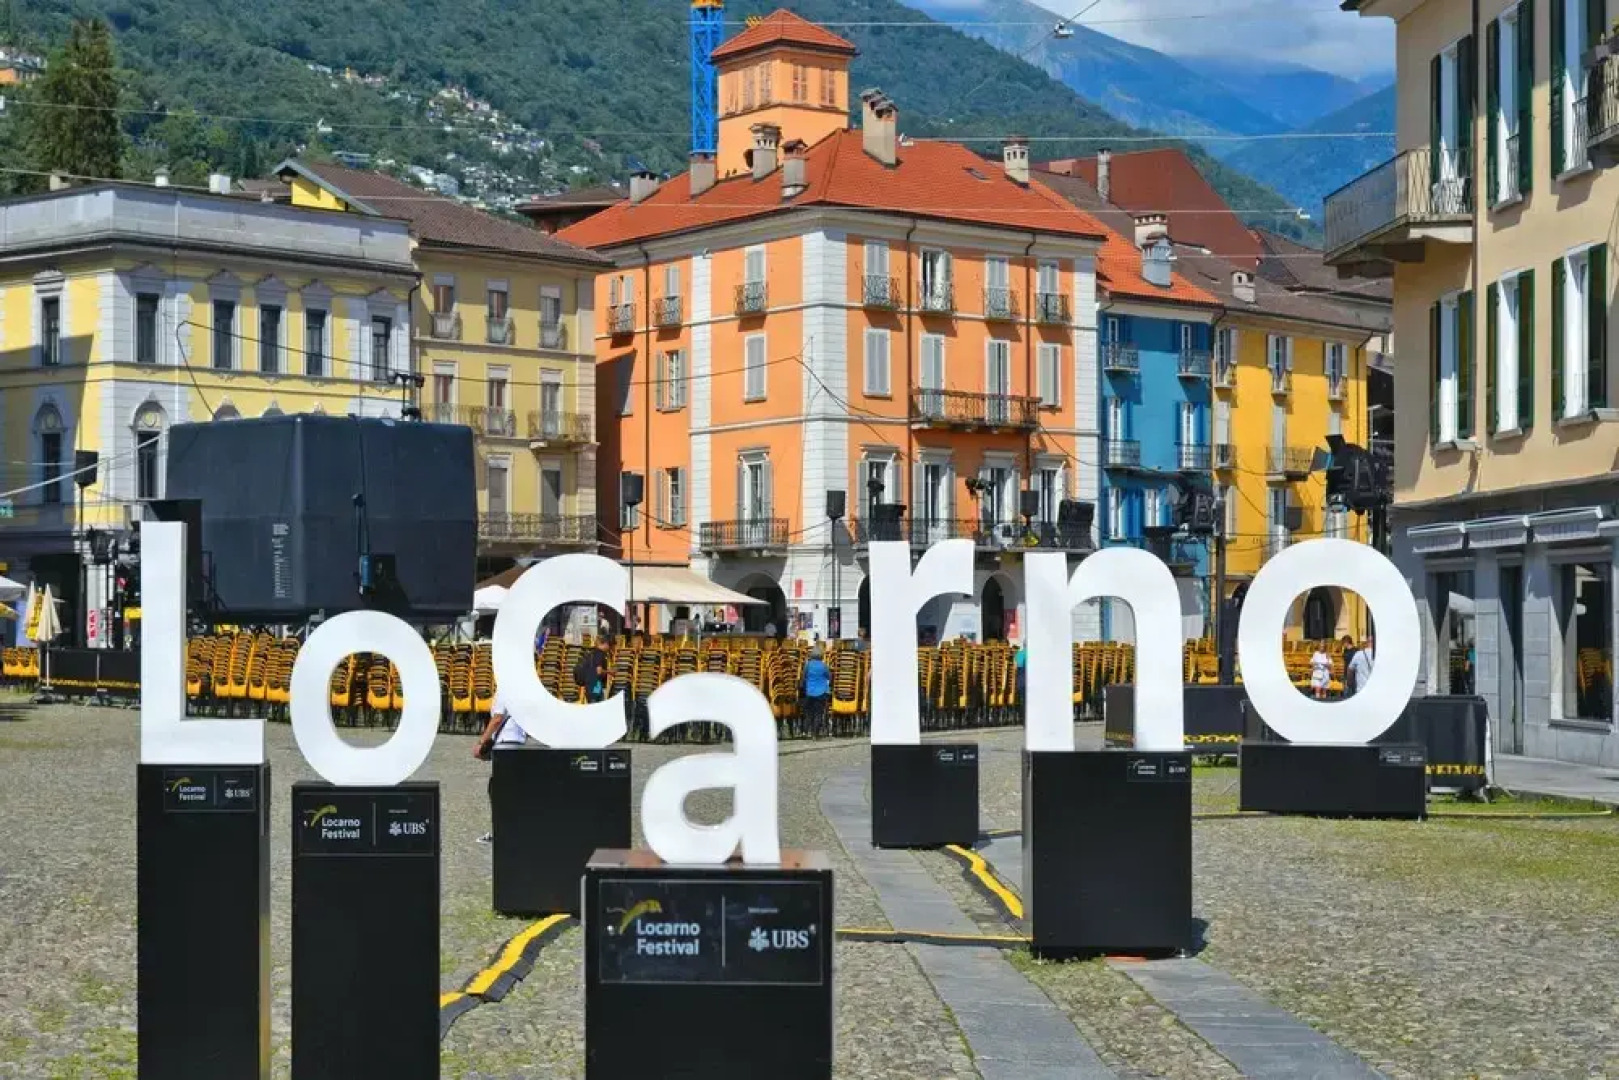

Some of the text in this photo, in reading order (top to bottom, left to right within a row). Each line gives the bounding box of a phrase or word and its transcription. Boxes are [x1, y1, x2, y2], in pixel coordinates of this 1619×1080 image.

[139, 520, 1423, 866] Locarno
[321, 818, 360, 827] Locarno
[402, 822, 426, 835] UBS
[321, 828, 360, 839] Festival
[636, 919, 700, 935] Locarno
[636, 939, 699, 955] Festival
[772, 929, 809, 949] UBS
